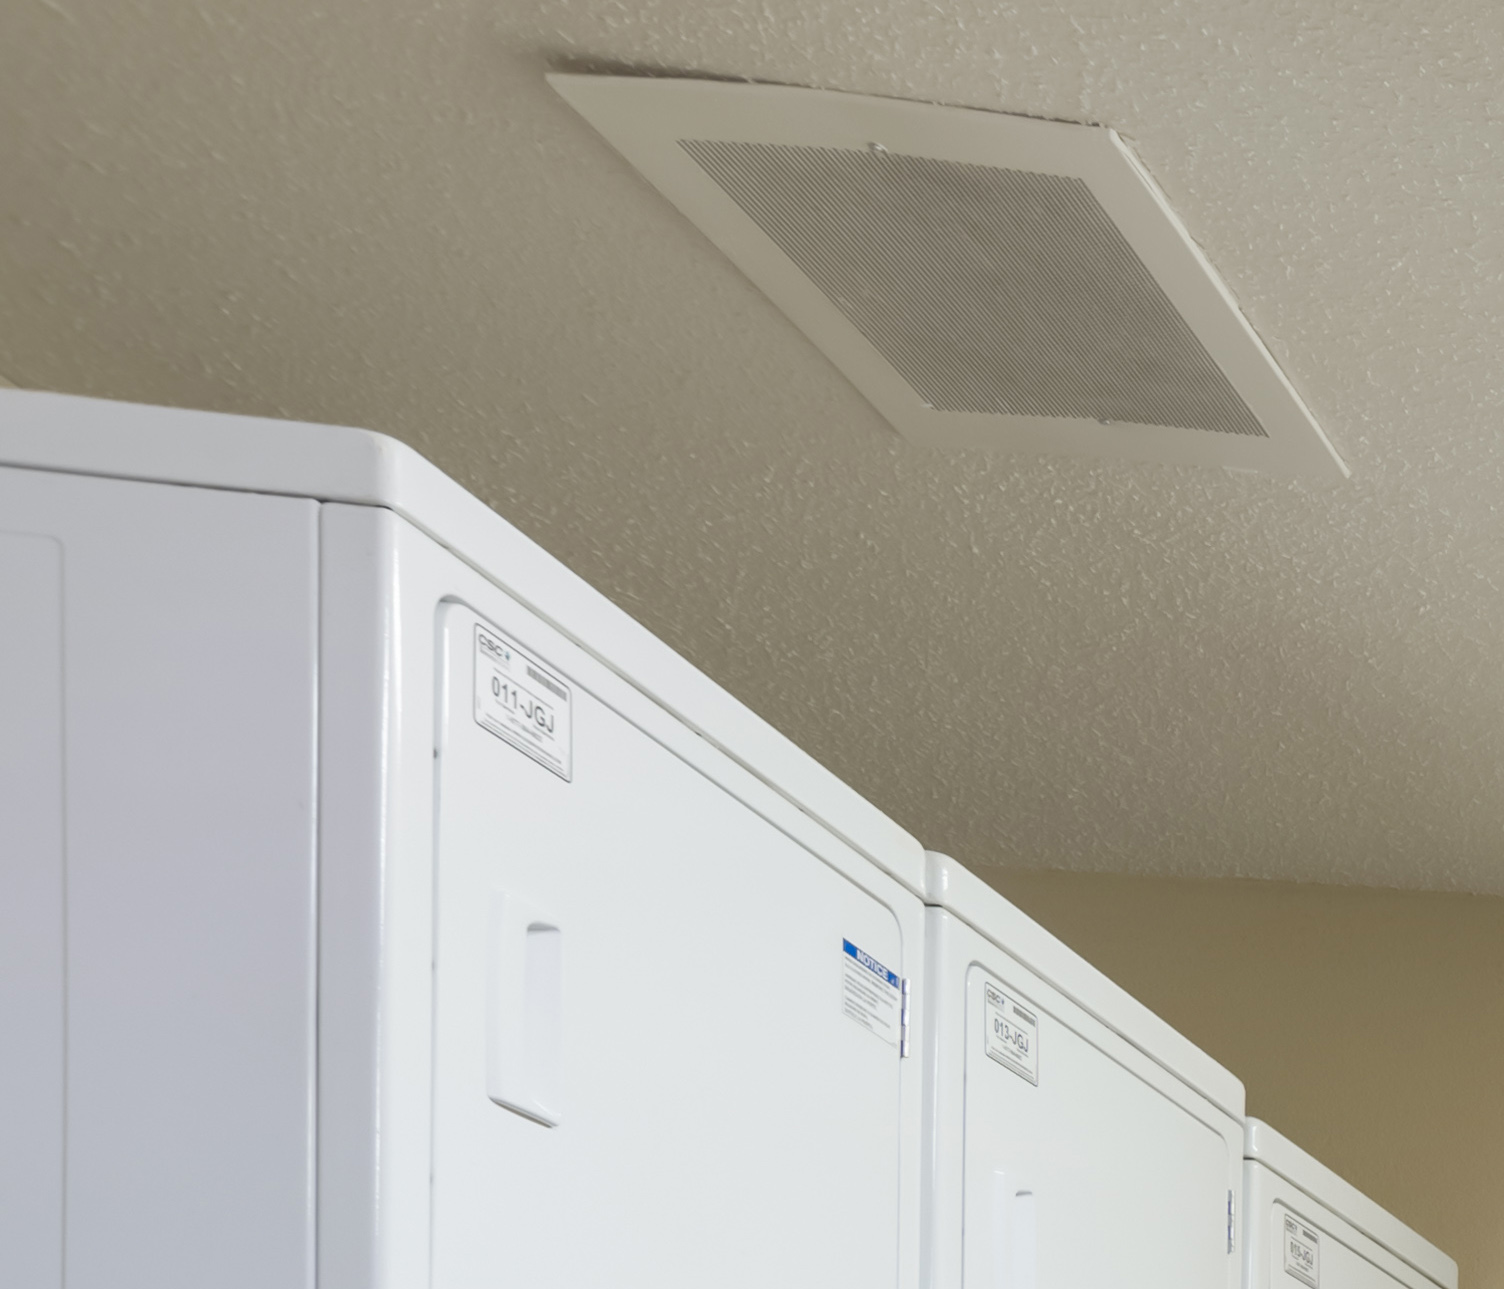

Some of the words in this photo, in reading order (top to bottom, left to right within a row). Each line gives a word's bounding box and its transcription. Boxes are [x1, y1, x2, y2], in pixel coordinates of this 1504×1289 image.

[478, 634, 503, 657] CSC
[491, 676, 554, 733] 011-JGJ
[856, 948, 889, 980] NOTICE
[994, 1018, 1029, 1053] 013-JGJ
